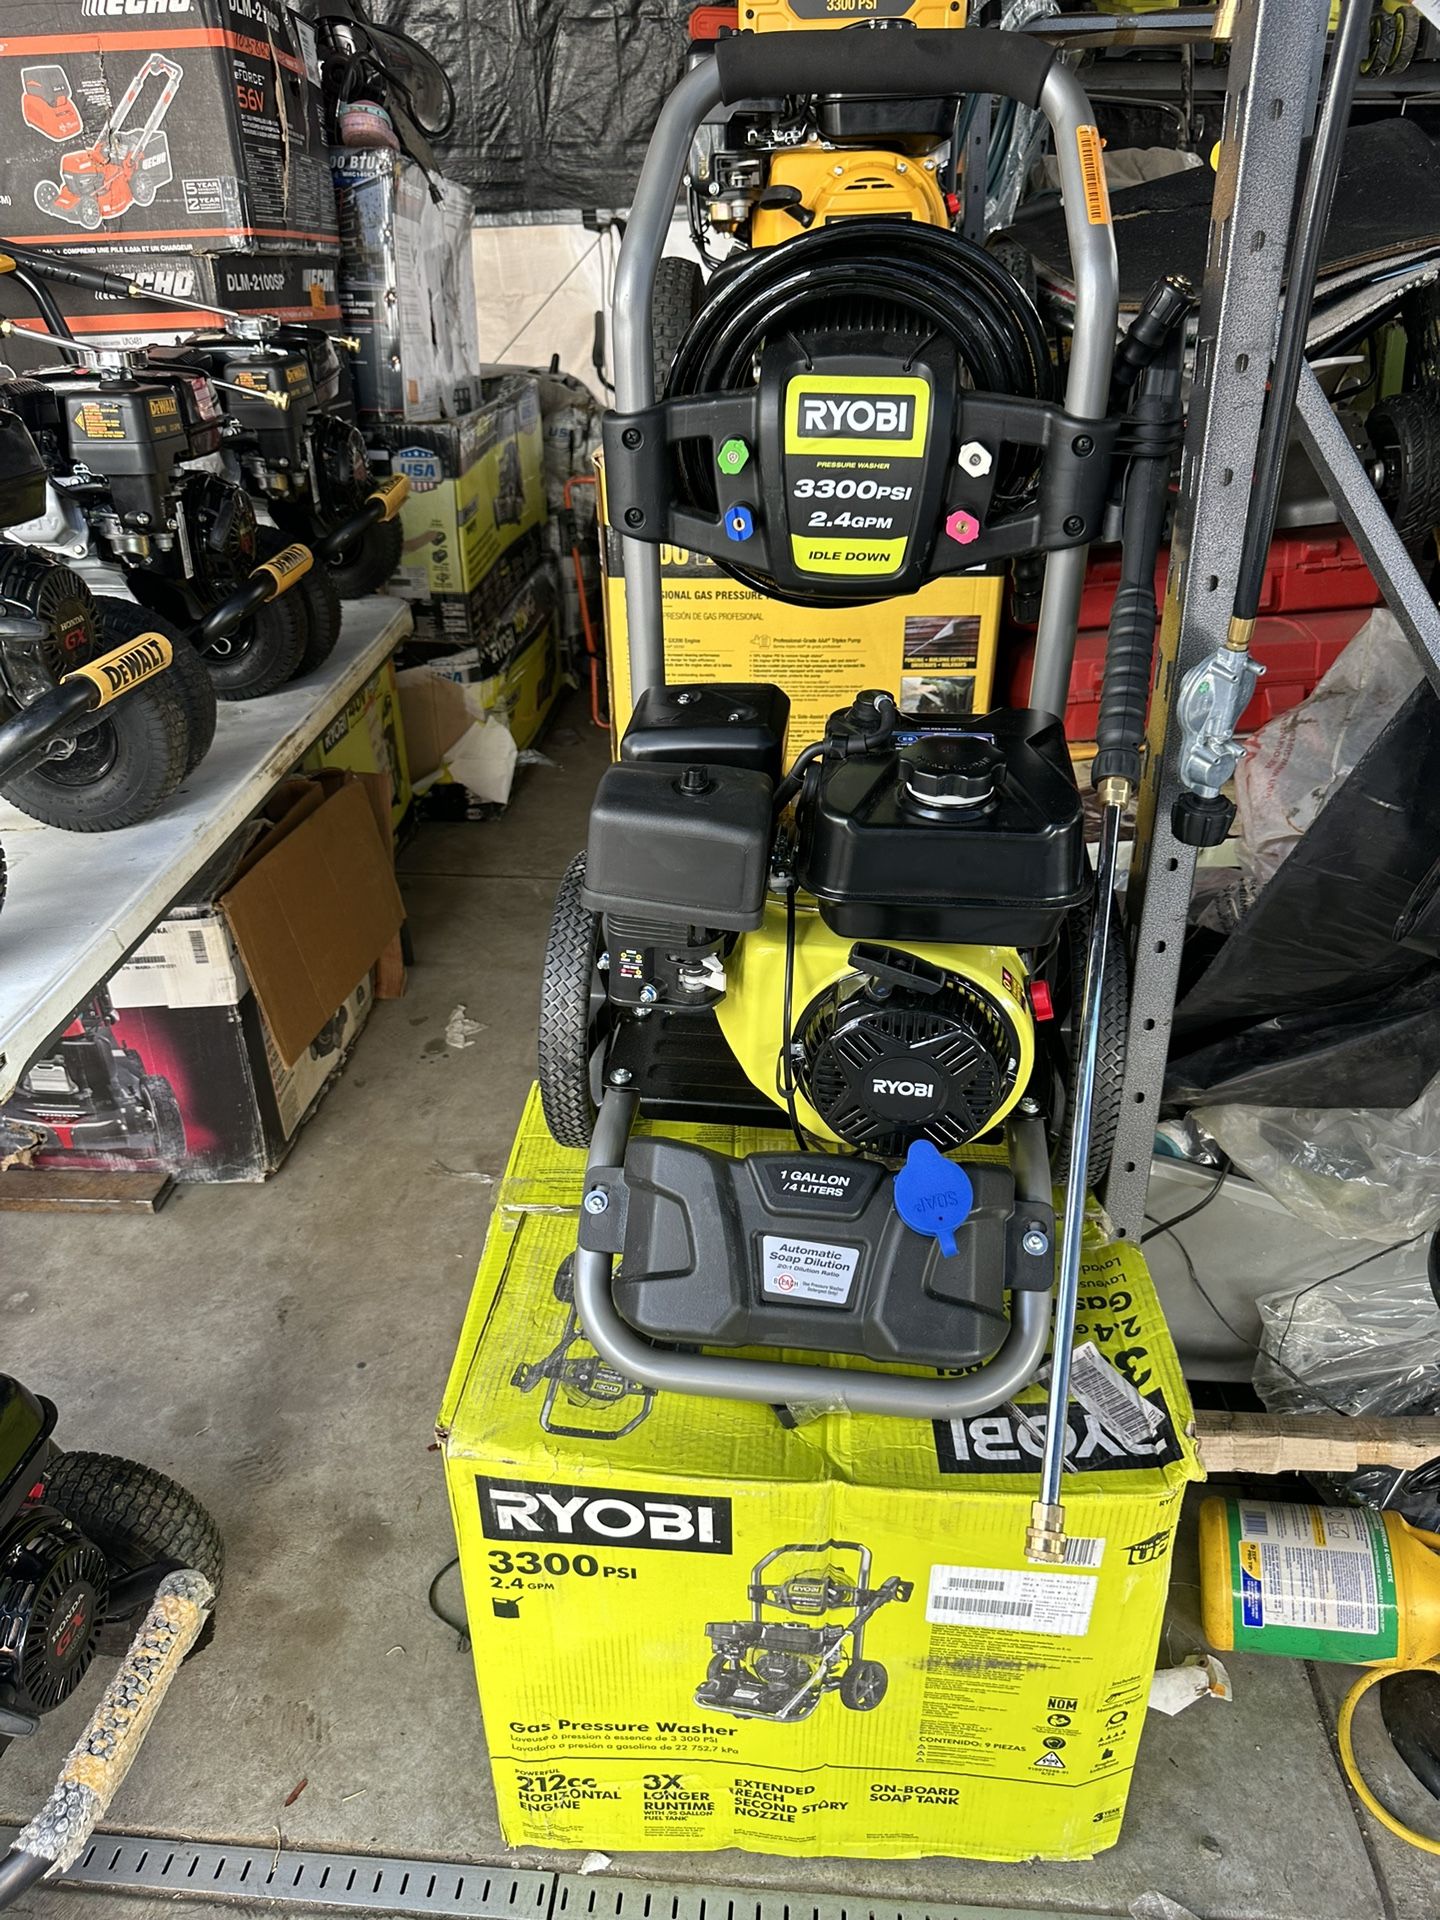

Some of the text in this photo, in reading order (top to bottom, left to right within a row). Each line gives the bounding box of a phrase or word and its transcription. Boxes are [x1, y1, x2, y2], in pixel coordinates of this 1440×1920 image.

[237, 85, 264, 112] 56V
[227, 273, 285, 292] DLM-2100SP
[804, 400, 908, 432] RYOBI
[401, 463, 435, 476] USA
[816, 461, 890, 470] PRESSURE WASHER
[794, 479, 912, 500] 3300PSI
[808, 511, 893, 529] 2.4GPM
[809, 551, 890, 562] IDLE DOWN
[694, 590, 713, 600] GAS
[715, 590, 763, 600] PRESSURE
[60, 615, 85, 631] HONDA
[100, 639, 164, 691] DEWALT
[872, 1079, 934, 1098] RYOBI
[780, 1170, 850, 1187] 1 GALLON
[800, 1184, 844, 1197] LITERS
[915, 1190, 959, 1212] SOAP
[779, 1243, 843, 1261] Automatic
[769, 1252, 850, 1272] Soap Dilution
[793, 1266, 821, 1276] Dilution
[821, 1270, 840, 1278] Ratio
[1078, 1274, 1127, 1287] Laveus
[1093, 1314, 1142, 1342] 2.4
[489, 1488, 714, 1543] RYOBI
[488, 1550, 637, 1580] 3300 PSI
[490, 1576, 555, 1590] 2.4 GPM
[52, 1594, 85, 1643] HONDA
[1048, 1698, 1077, 1710] NOM
[509, 1719, 738, 1737] Gas Pressure Washer
[561, 1733, 601, 1741] pression
[919, 1736, 981, 1747] CONTENIDO:
[993, 1743, 1026, 1752] PIEZAS
[511, 1743, 555, 1752] Lavadora
[567, 1742, 604, 1750] presión
[616, 1743, 657, 1752] gasolina
[659, 1743, 673, 1751] de
[515, 1768, 560, 1776] POWERFUL
[517, 1774, 597, 1792] 212cc
[642, 1774, 684, 1790] 3X
[734, 1778, 815, 1795] EXTENDED
[871, 1784, 960, 1796] ON-BOARD
[519, 1789, 622, 1802] HORIZONTAL
[643, 1791, 710, 1801] LONGER
[735, 1788, 784, 1803] REACH
[870, 1793, 959, 1805] SOAP TANK
[520, 1800, 580, 1812] ENGINE
[644, 1801, 715, 1811] RUNTIME
[735, 1797, 849, 1814] SECOND STORY
[735, 1806, 796, 1823] NOZZLE
